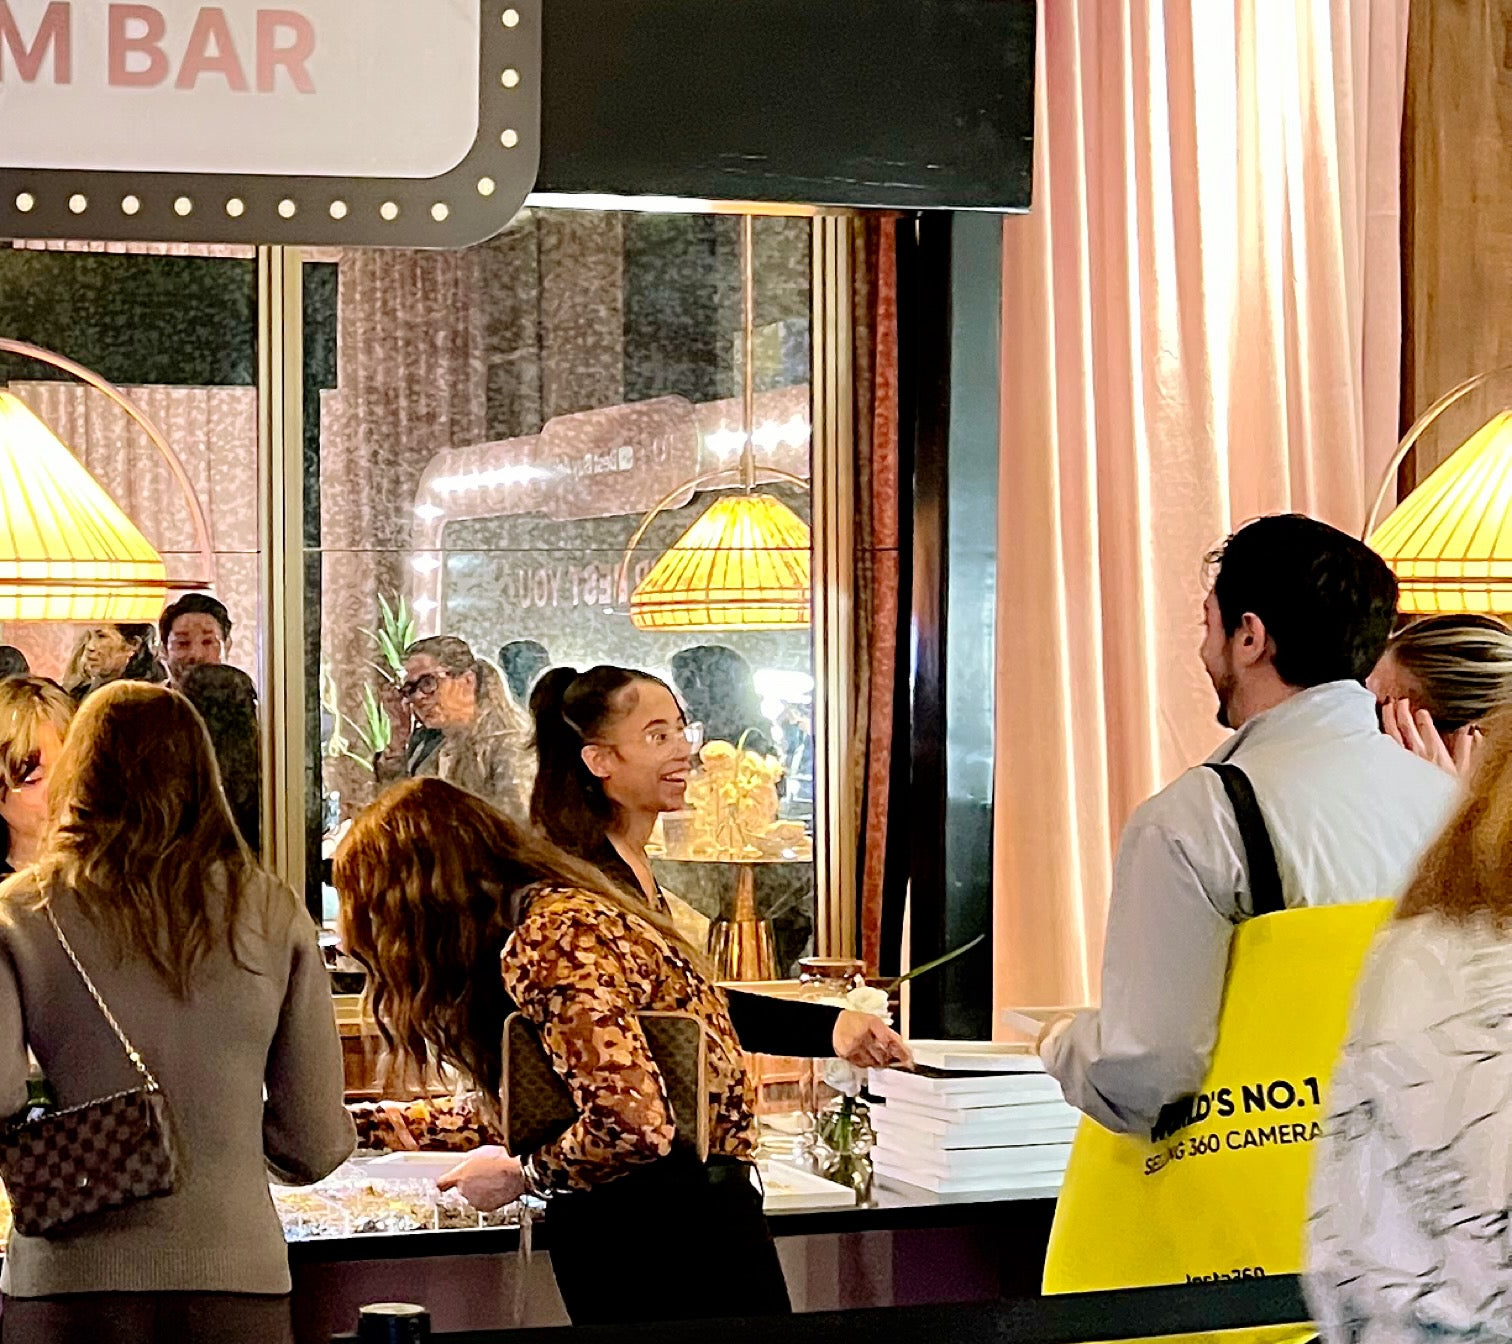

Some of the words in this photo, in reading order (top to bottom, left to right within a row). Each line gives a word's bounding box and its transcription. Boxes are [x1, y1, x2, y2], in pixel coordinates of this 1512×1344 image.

[108, 4, 318, 95] BAR
[1242, 1076, 1321, 1113] NO.1
[1144, 1142, 1185, 1175] SENG
[1188, 1134, 1220, 1157] 360
[1226, 1121, 1324, 1150] CAMERA
